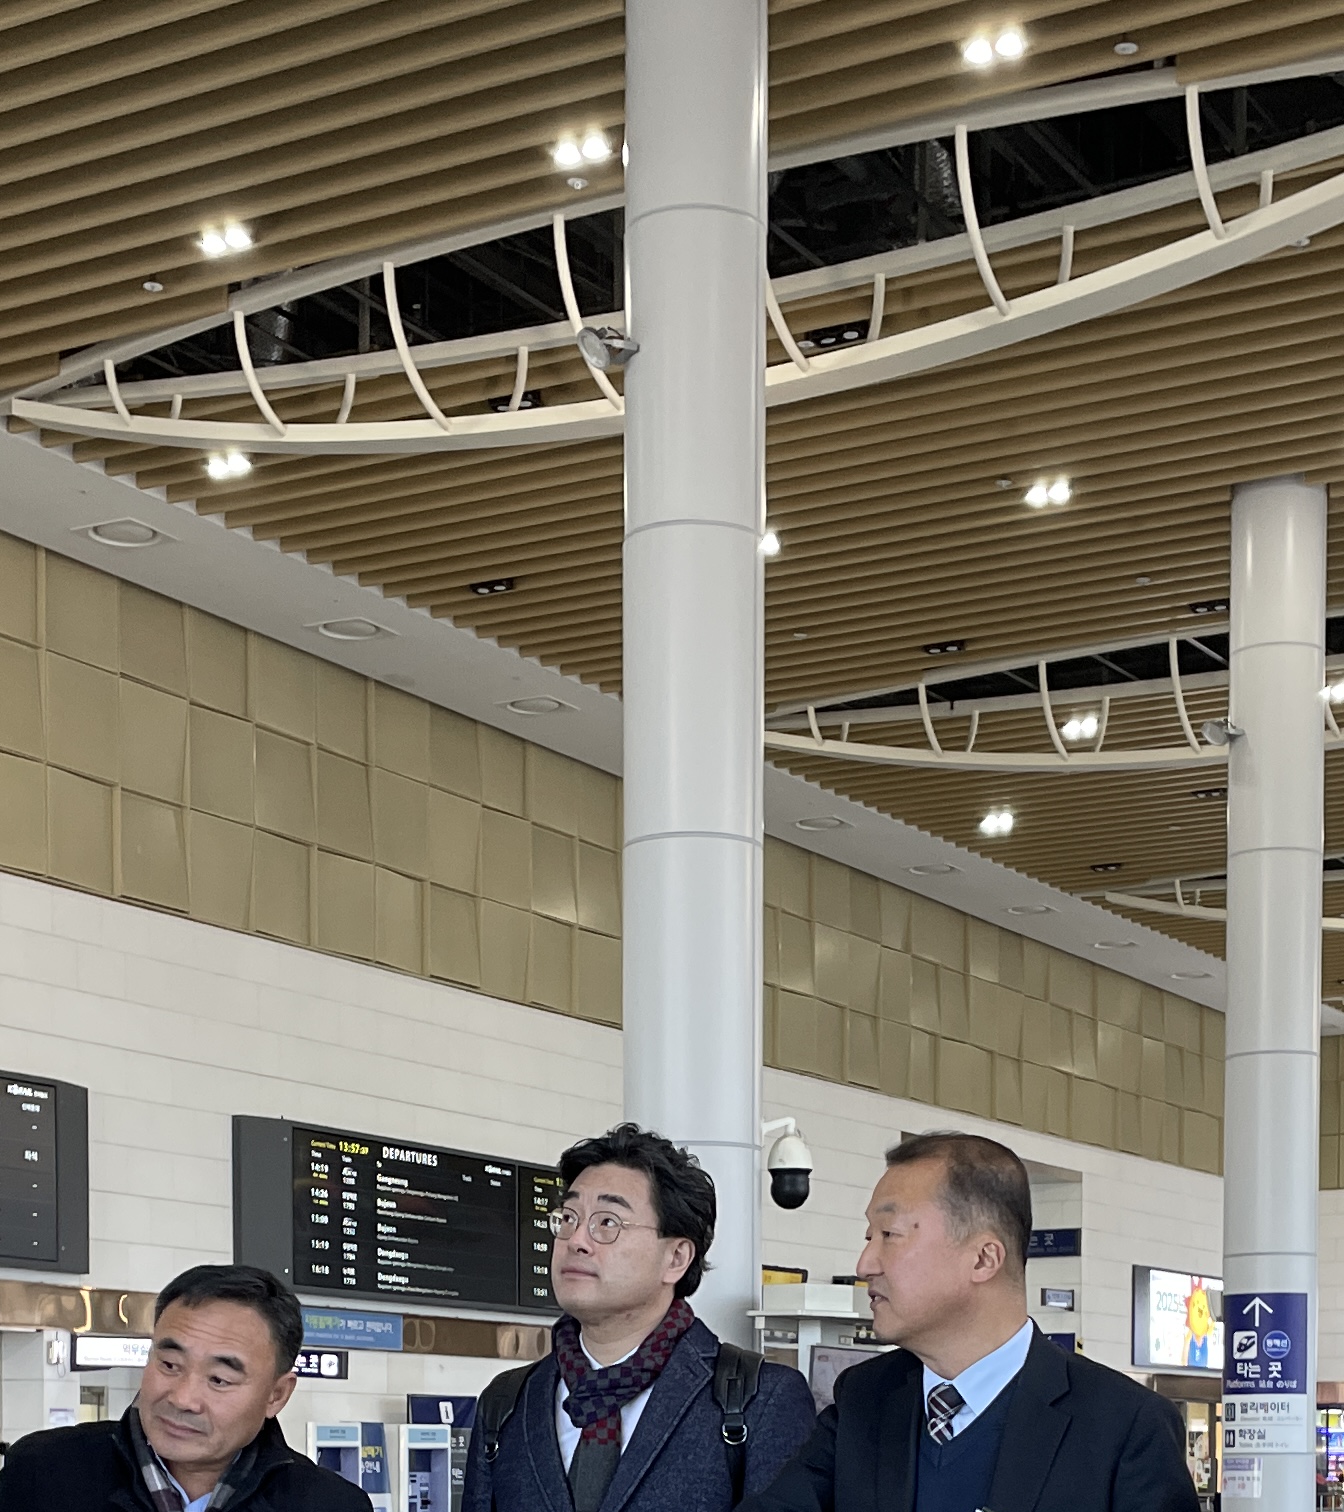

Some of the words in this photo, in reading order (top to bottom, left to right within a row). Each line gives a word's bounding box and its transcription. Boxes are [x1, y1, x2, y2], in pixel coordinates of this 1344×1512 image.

[382, 1146, 438, 1167] DEPARTURES
[1236, 1362, 1261, 1378] 타는
[1268, 1361, 1282, 1378] 곳
[1240, 1402, 1290, 1414] 엘리베이터
[1238, 1428, 1266, 1440] 화장실
